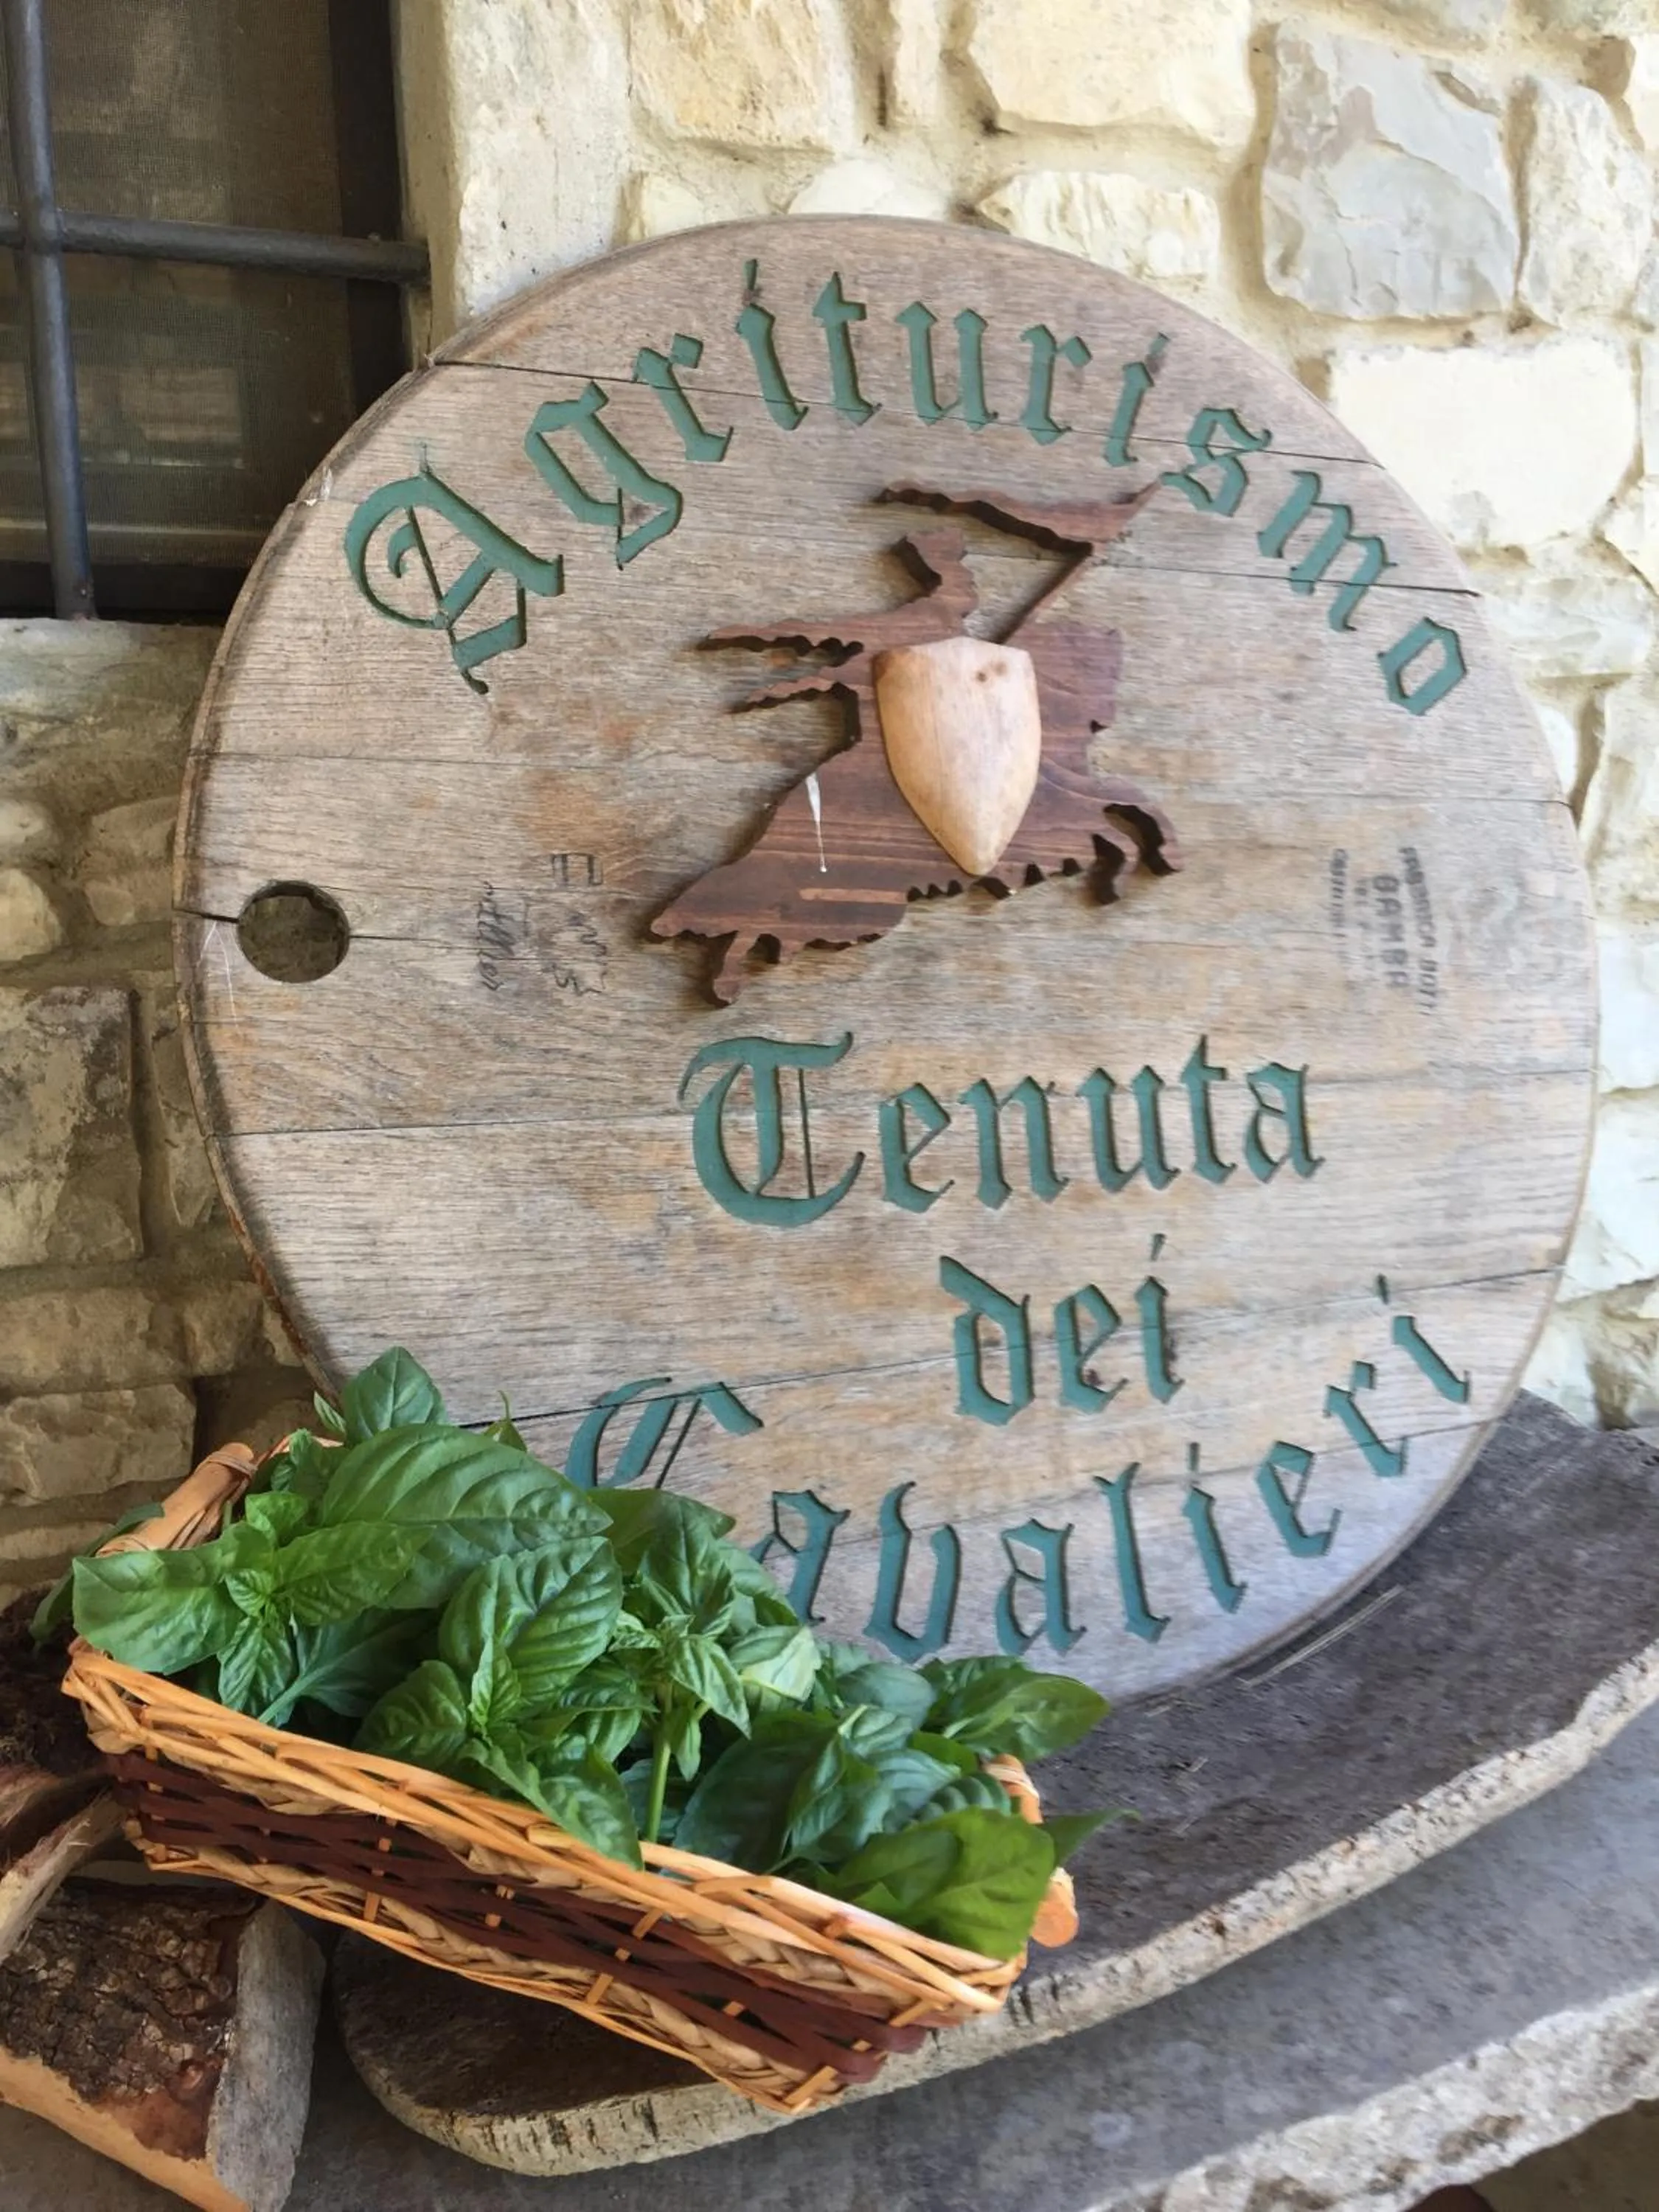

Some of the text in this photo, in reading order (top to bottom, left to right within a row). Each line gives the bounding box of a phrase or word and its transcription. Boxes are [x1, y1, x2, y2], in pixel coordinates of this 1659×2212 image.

[344, 258, 1468, 715] Agriturismo
[679, 1031, 1324, 1229] Tenuta
[938, 1234, 1183, 1426] dei
